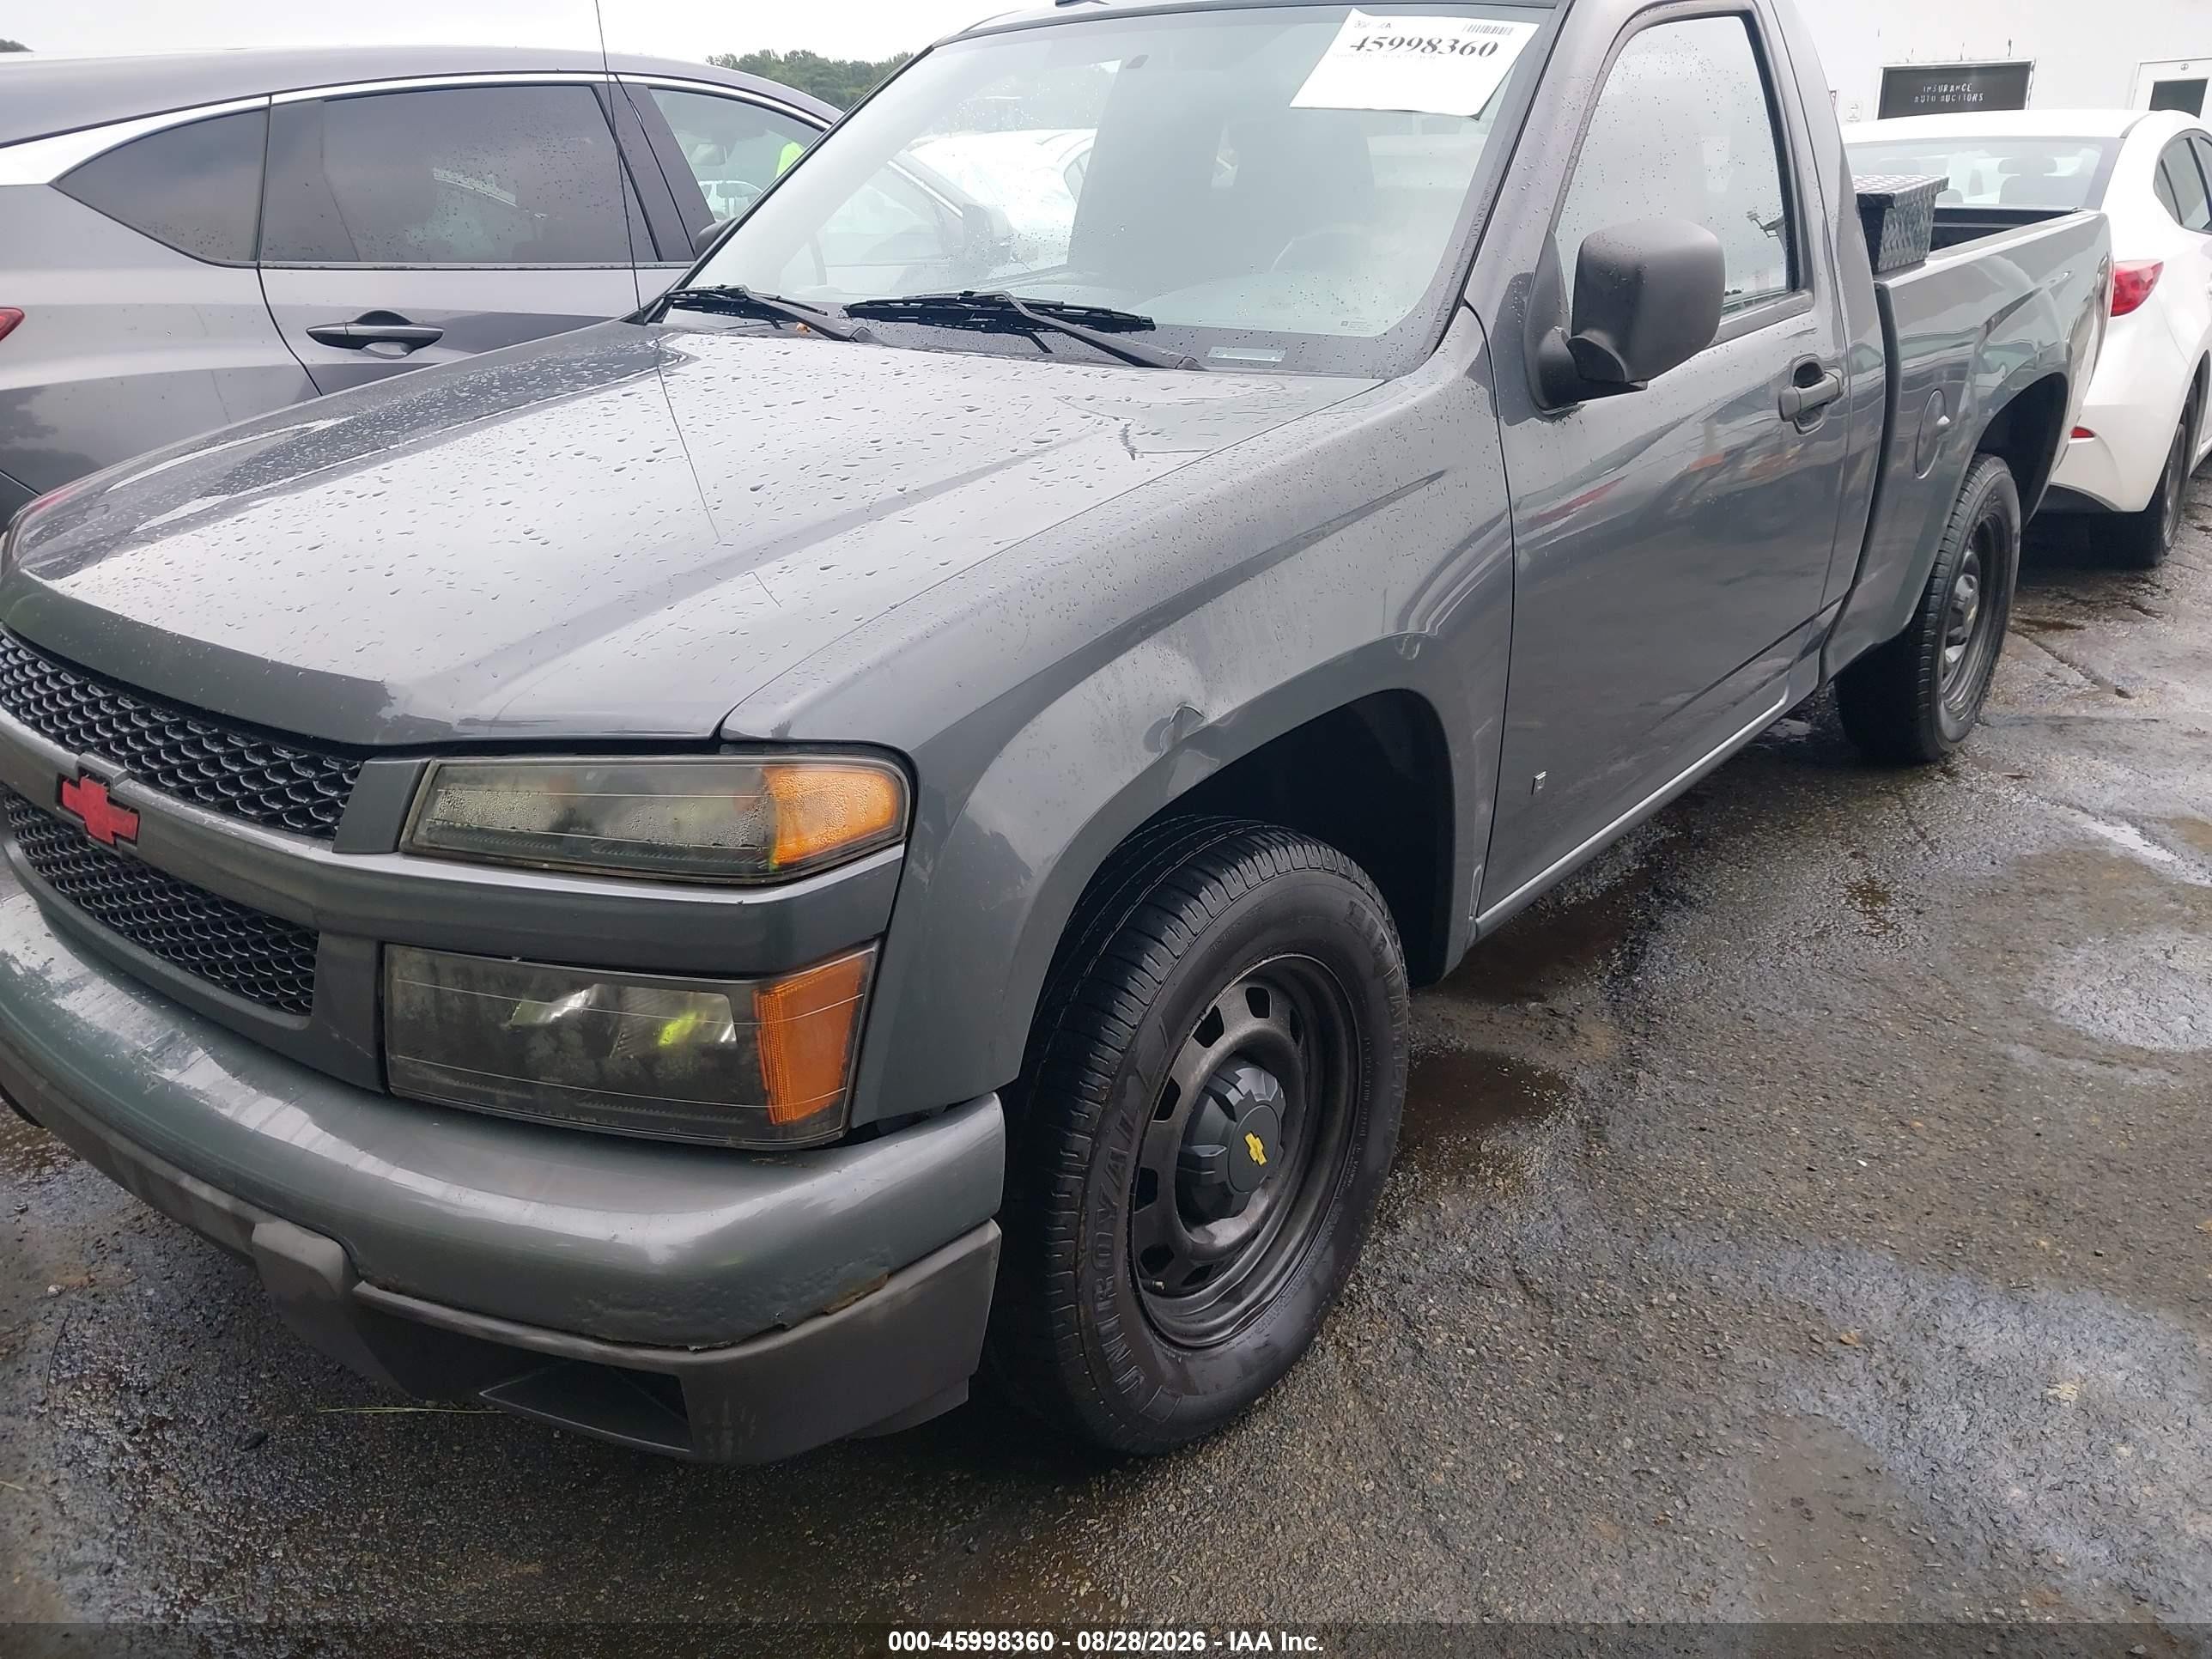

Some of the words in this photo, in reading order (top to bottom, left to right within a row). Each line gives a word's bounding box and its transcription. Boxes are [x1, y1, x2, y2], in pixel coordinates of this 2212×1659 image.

[1350, 35, 1500, 58] 45998360
[1923, 82, 1972, 93] INSURANCE
[1914, 94, 1936, 103] AUTO
[1941, 93, 1984, 102] AUCTIONS
[1091, 1106, 1146, 1396] UNIROYAL
